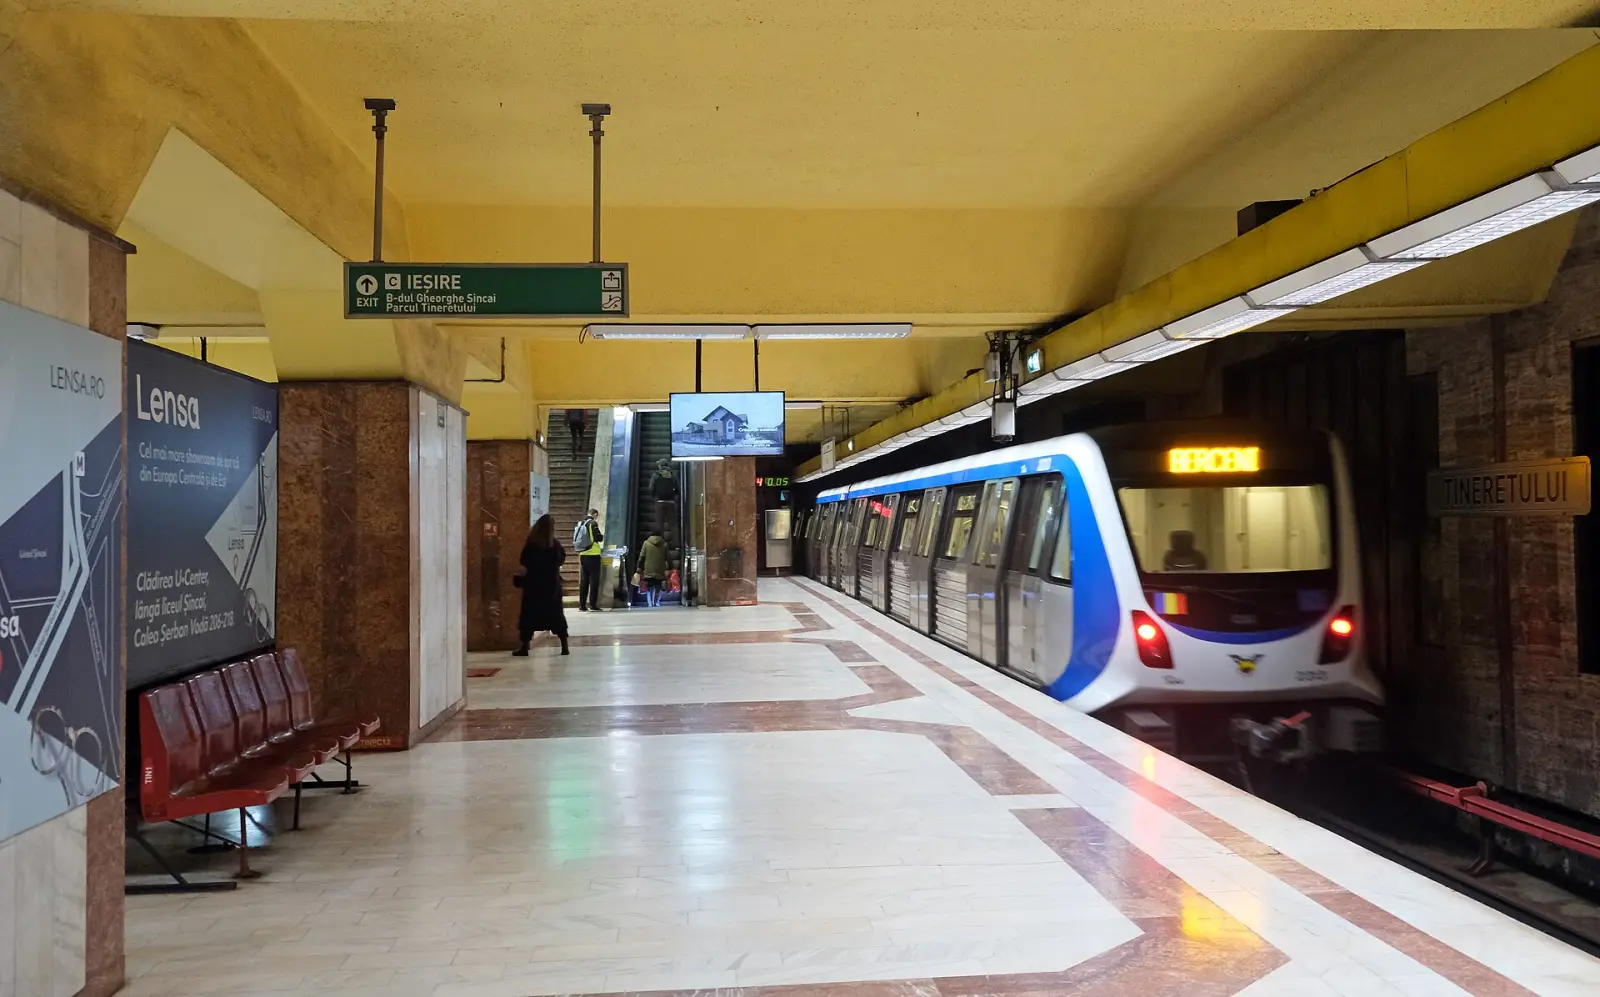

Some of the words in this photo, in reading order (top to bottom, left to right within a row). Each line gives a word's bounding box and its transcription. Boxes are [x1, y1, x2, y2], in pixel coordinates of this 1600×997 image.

[389, 276, 398, 287] C
[407, 274, 461, 293] IEȘIRE
[356, 298, 379, 307] EXIT
[386, 294, 414, 303] B-dul
[416, 293, 465, 305] Gheorghe
[467, 293, 496, 303] Sincai
[386, 303, 419, 313] Parcul
[421, 303, 476, 313] Tineretului
[50, 364, 105, 400] LENSA.RO
[136, 373, 200, 430] Lensa
[139, 441, 152, 459] Cel
[153, 445, 166, 460] mai
[153, 466, 178, 488] Europa
[1444, 470, 1567, 505] TINERETULUI
[136, 571, 173, 592] Clădirea
[134, 598, 160, 623] lângă
[133, 626, 159, 648] Calea
[160, 620, 189, 648] Șerban
[190, 615, 209, 636] Vodă
